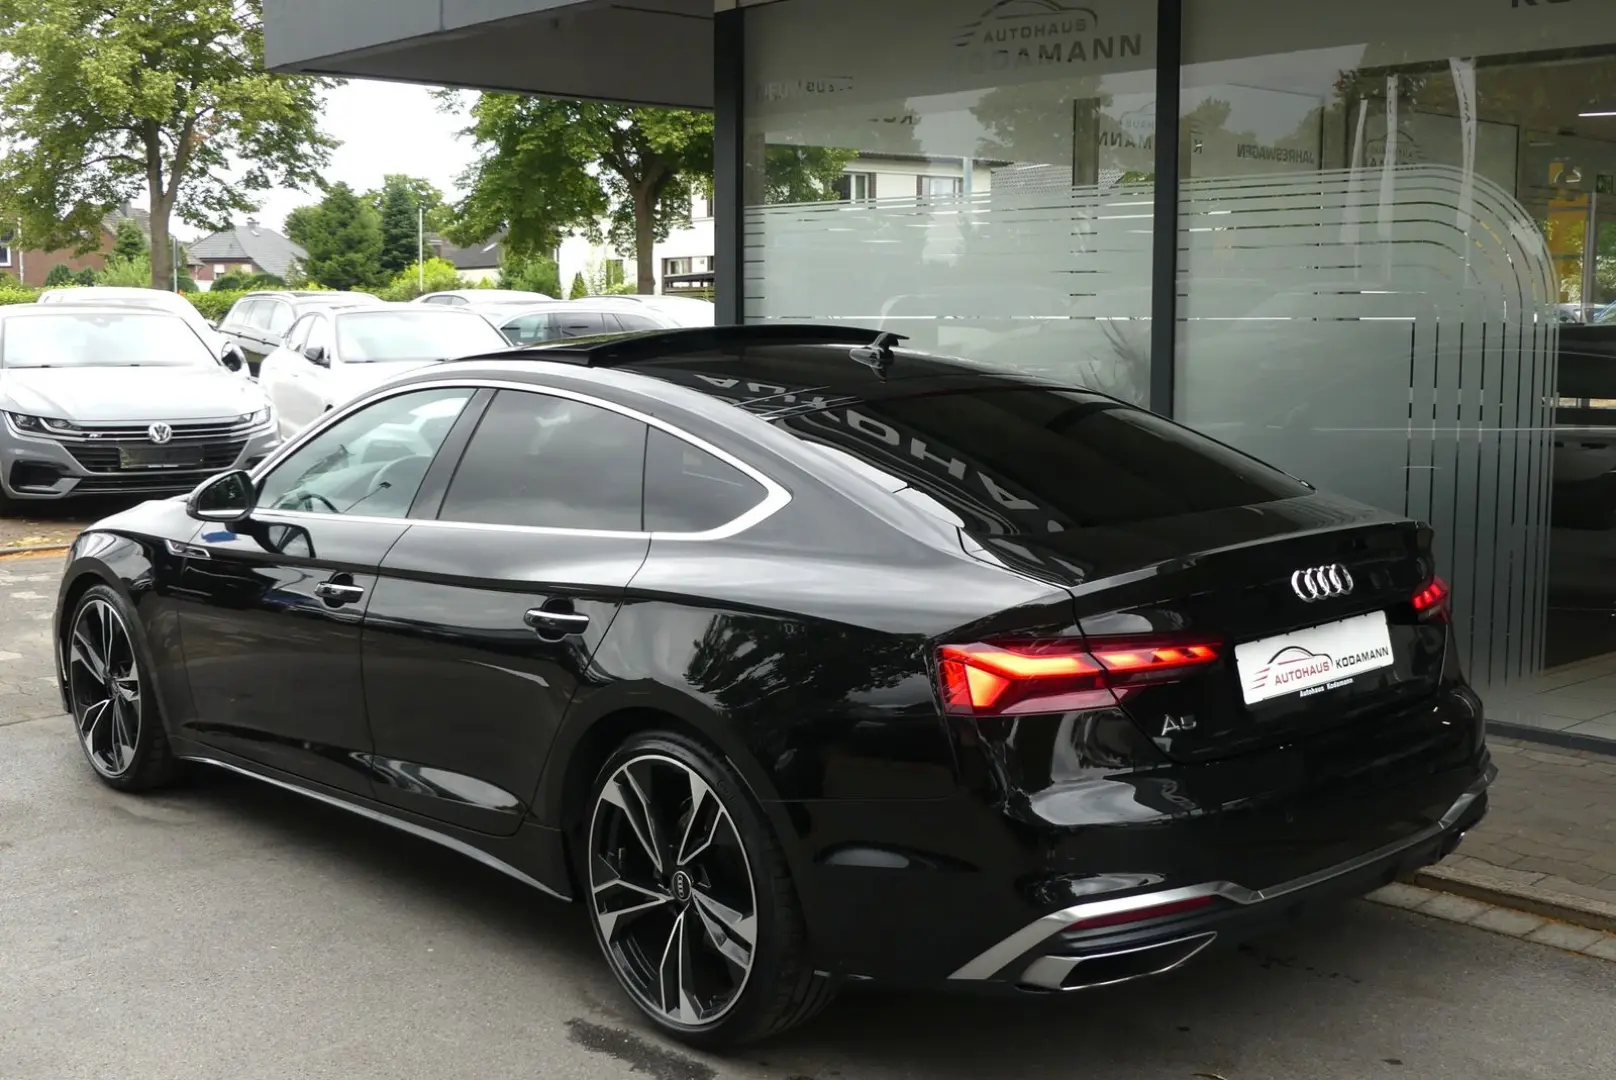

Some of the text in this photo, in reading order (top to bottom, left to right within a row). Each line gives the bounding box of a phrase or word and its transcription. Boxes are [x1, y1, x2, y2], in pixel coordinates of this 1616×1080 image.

[983, 18, 1087, 44] AUTOHAUS
[1274, 645, 1390, 686] AUTOHAUS KODAMANN
[1299, 686, 1325, 698] Autohaus
